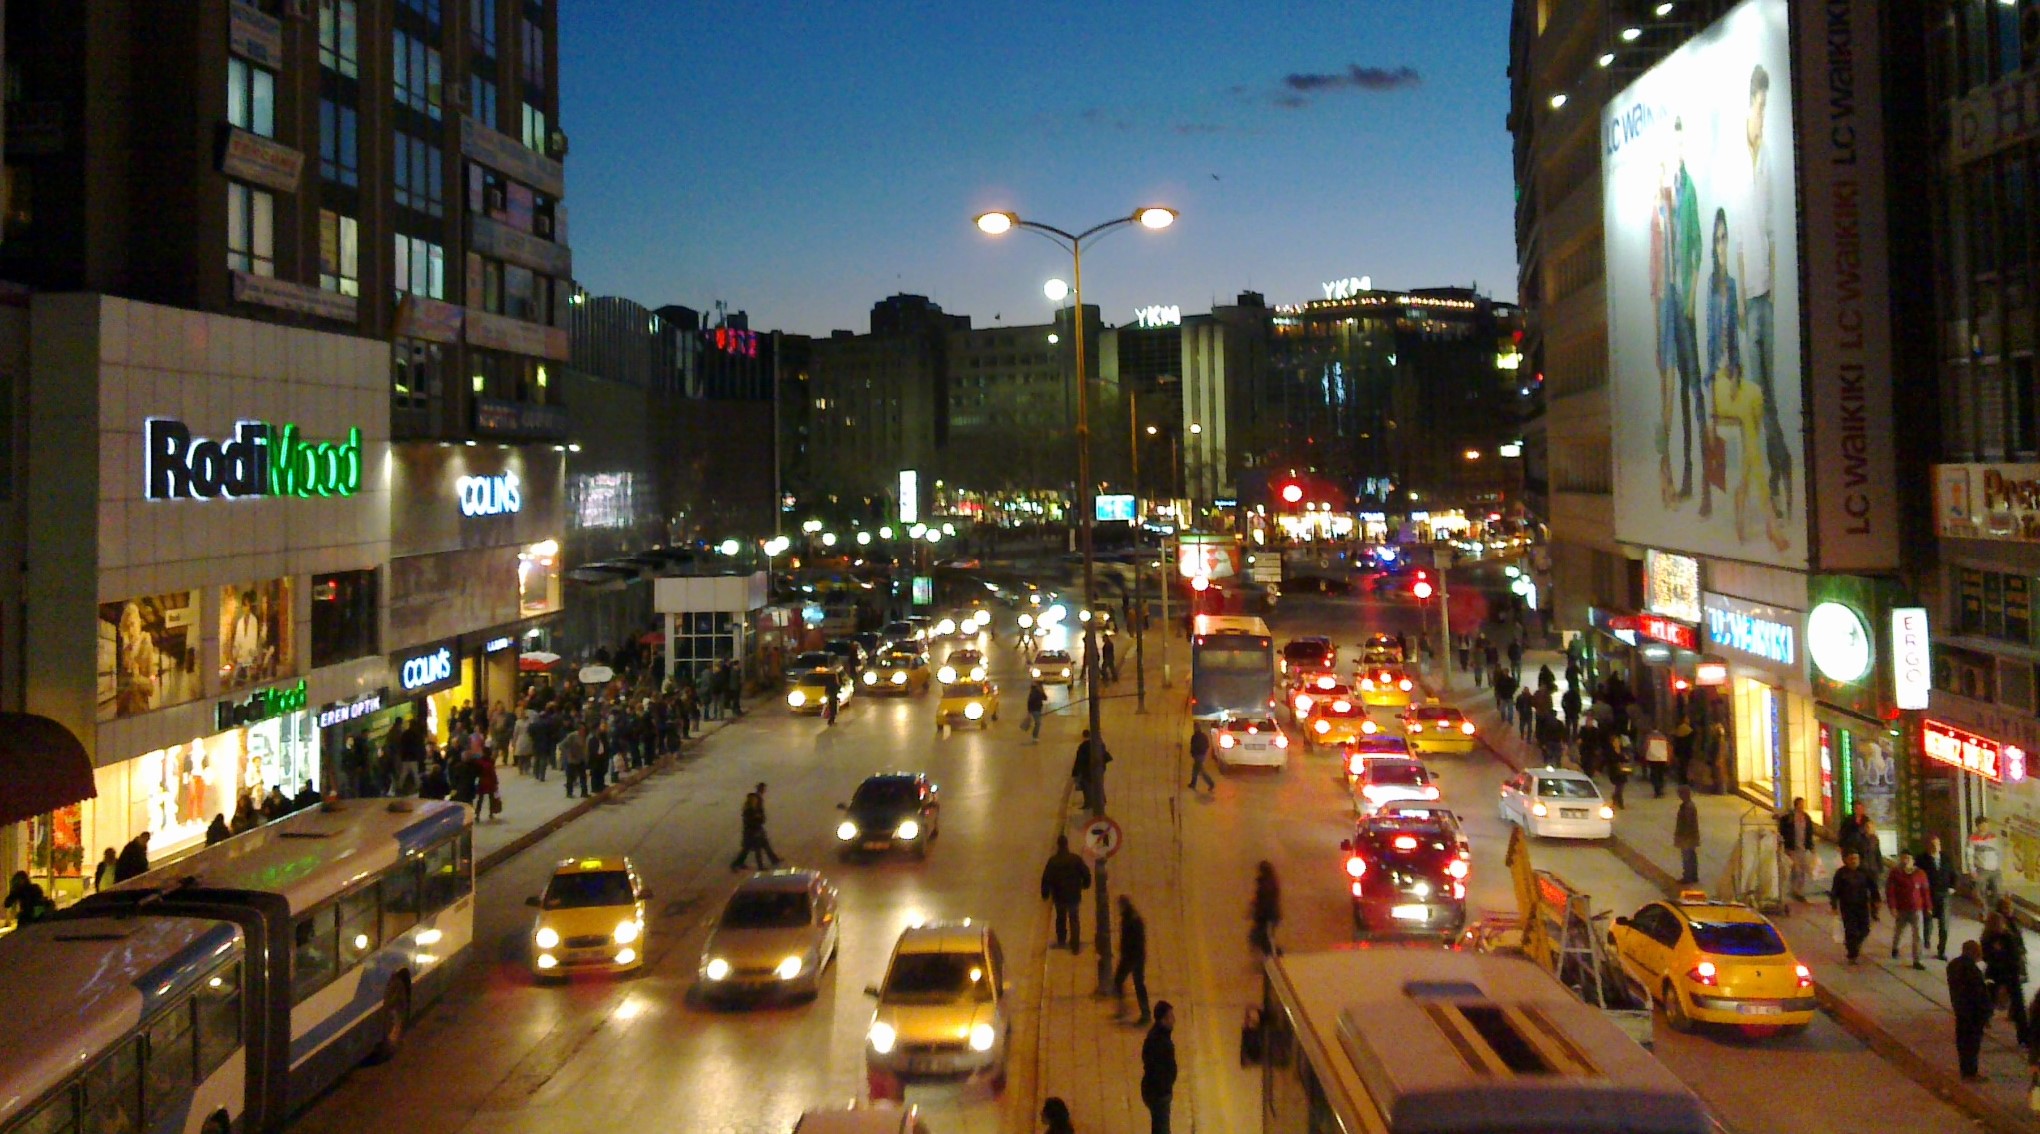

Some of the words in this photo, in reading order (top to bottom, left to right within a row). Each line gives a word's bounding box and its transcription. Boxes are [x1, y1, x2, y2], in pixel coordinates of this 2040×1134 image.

[1831, 125, 1857, 164] LC
[1321, 276, 1371, 300] YKM
[1134, 304, 1180, 328] YKM
[1838, 309, 1863, 349] LC
[1845, 493, 1870, 534] LC
[1903, 616, 1922, 683] ERGO
[320, 707, 349, 728] EREN
